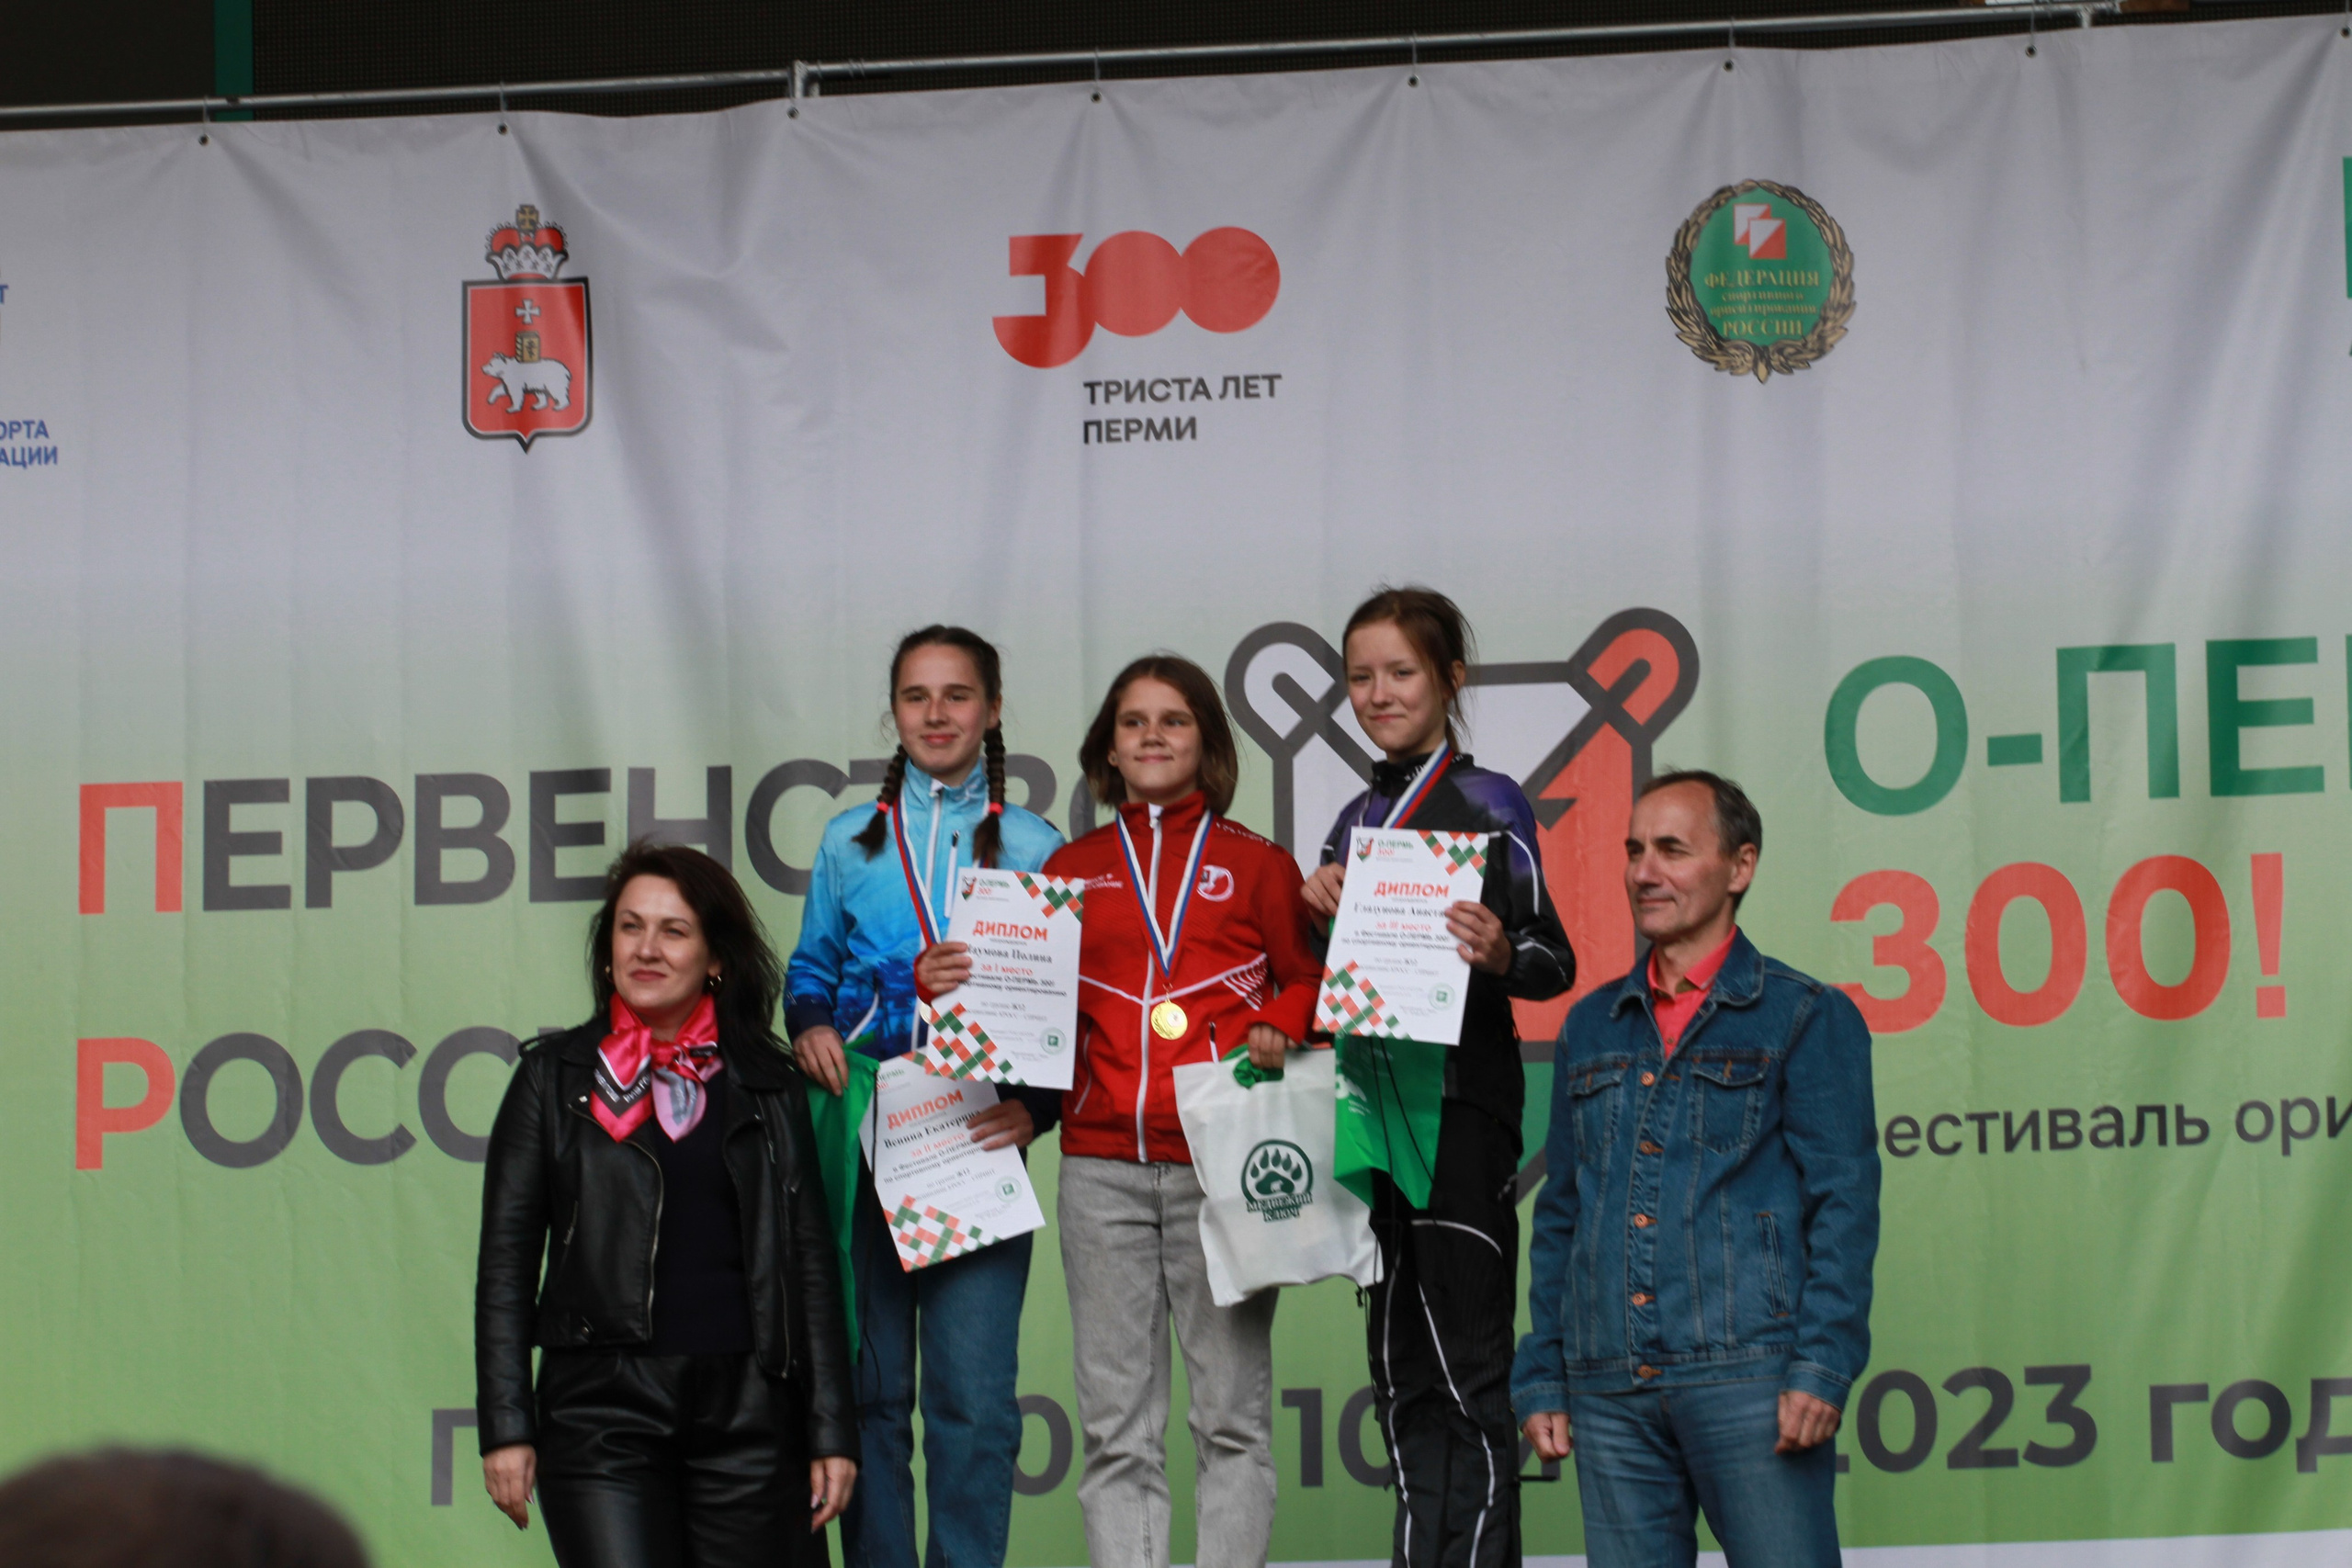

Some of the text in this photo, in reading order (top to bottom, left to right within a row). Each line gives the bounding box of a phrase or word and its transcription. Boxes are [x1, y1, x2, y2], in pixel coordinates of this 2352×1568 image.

[1704, 269, 1819, 288] ФЕДЕРАЦИЯ
[1722, 319, 1803, 336] РОССИИ
[1082, 373, 1282, 405] ТРИСТА ЛЕТ
[1082, 416, 1197, 444] ПЕРМИ
[1825, 634, 2352, 817] О-ПЕ
[1374, 880, 1450, 898] ДИПЛОМ
[972, 919, 1047, 942] ДИПЛОМ
[1829, 852, 2287, 1034] 300!
[886, 1089, 964, 1131] ДИПЛОМ
[1871, 1100, 2210, 1160] естиваль
[1835, 1363, 2098, 1474] 023
